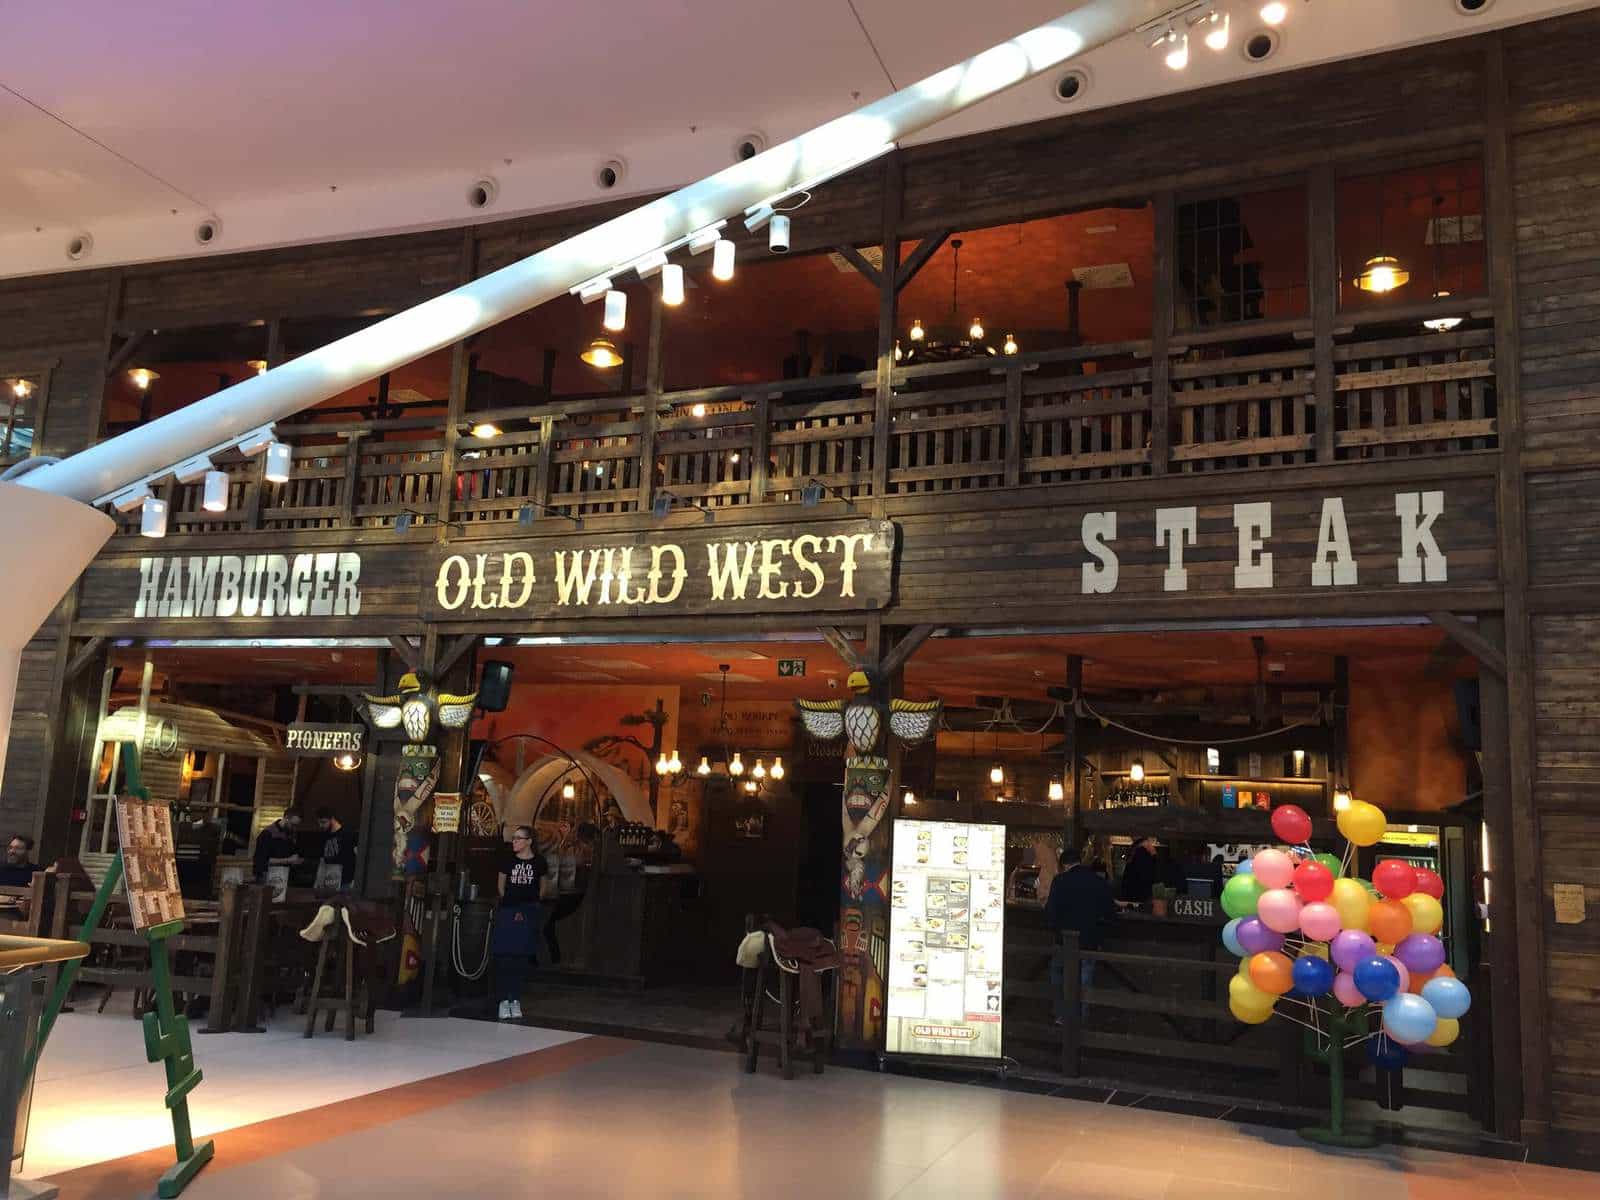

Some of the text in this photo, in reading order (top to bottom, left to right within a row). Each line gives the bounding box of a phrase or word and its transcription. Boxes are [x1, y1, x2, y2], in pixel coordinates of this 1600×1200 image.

[1081, 491, 1448, 594] STEAK
[435, 533, 873, 610] OLD WILD WEST
[134, 552, 362, 617] HAMBURGER
[286, 730, 362, 751] PIONEERS
[511, 876, 534, 884] WEST
[512, 869, 534, 877] WILD
[1174, 899, 1214, 916] CASH
